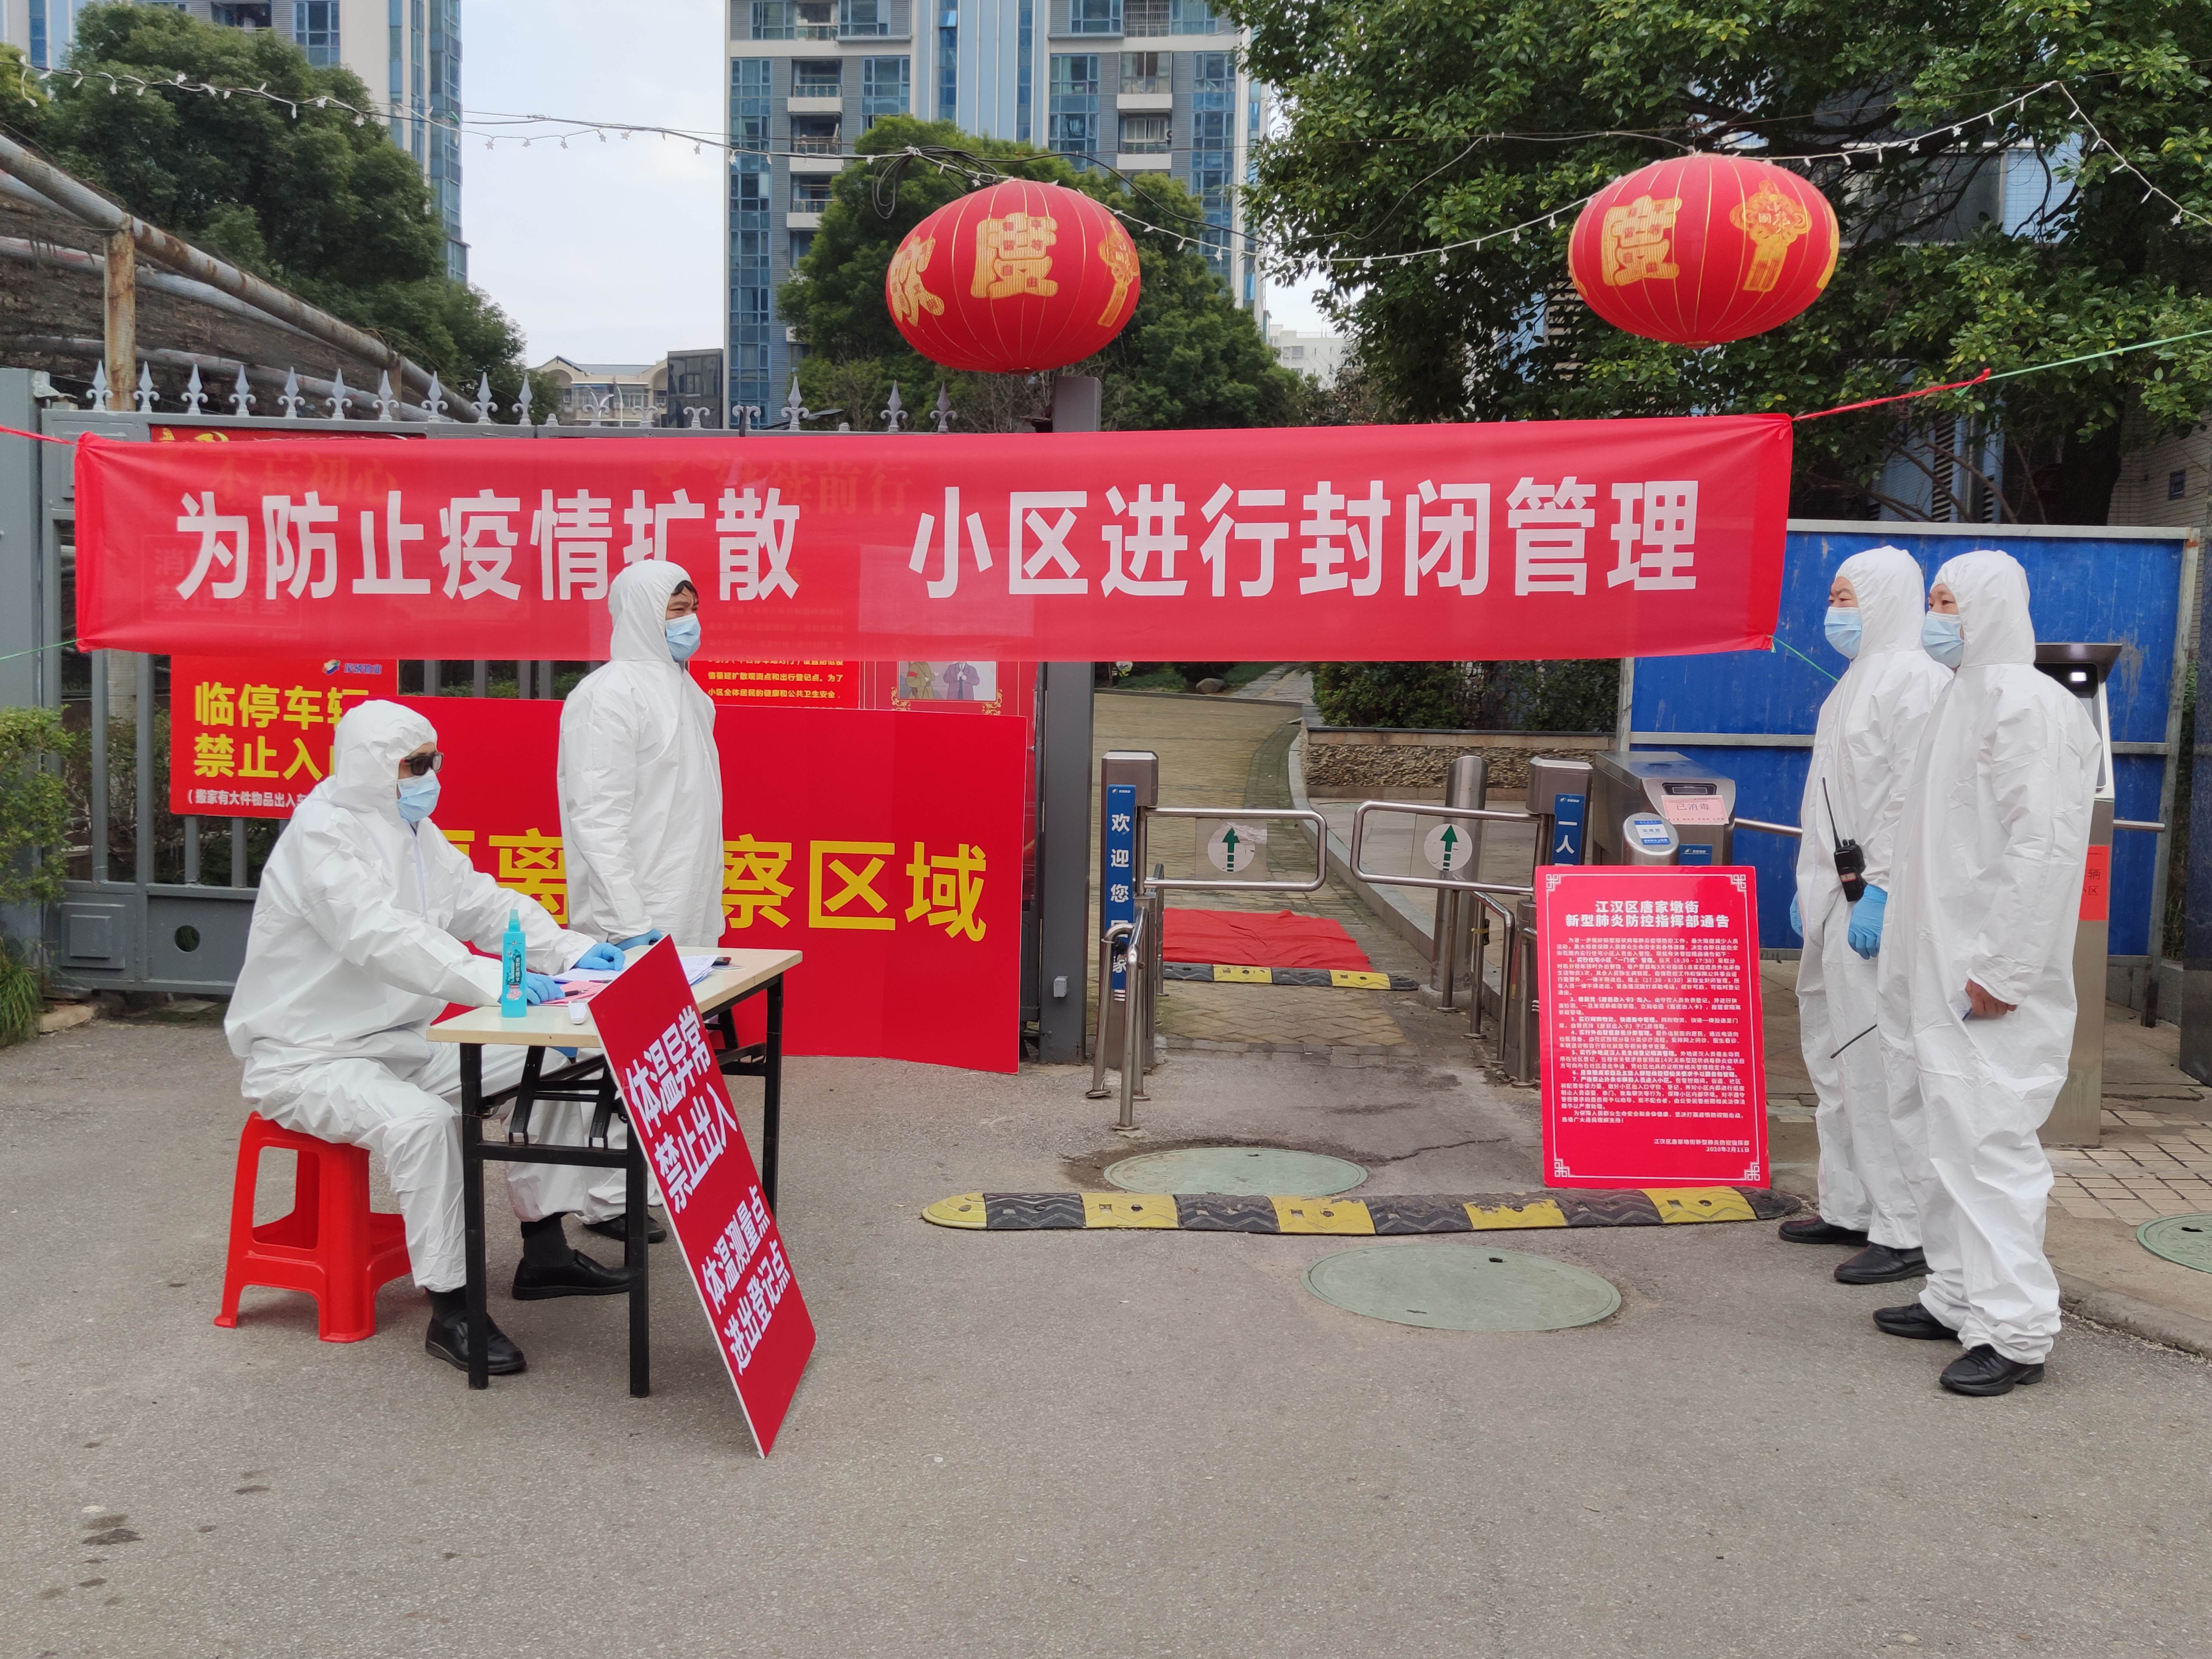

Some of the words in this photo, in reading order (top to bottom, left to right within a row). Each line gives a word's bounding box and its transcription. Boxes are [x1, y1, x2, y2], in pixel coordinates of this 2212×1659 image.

[176, 487, 800, 601] 为防止疫情扩散
[908, 477, 1698, 599] 小区进行封闭管理
[194, 733, 335, 781] 禁止入
[443, 827, 988, 942] 离察区域
[1565, 914, 1730, 927] 新型肺炎防控指挥部通告
[1595, 900, 1699, 913] 江汉区唐家墩街
[2083, 885, 2099, 896] 区
[2085, 868, 2101, 880] 辆
[626, 1005, 713, 1138] 体温异常
[654, 1082, 738, 1214] 禁止出入
[701, 1185, 772, 1315] 体温测量点
[724, 1239, 791, 1376] 进出登记点
